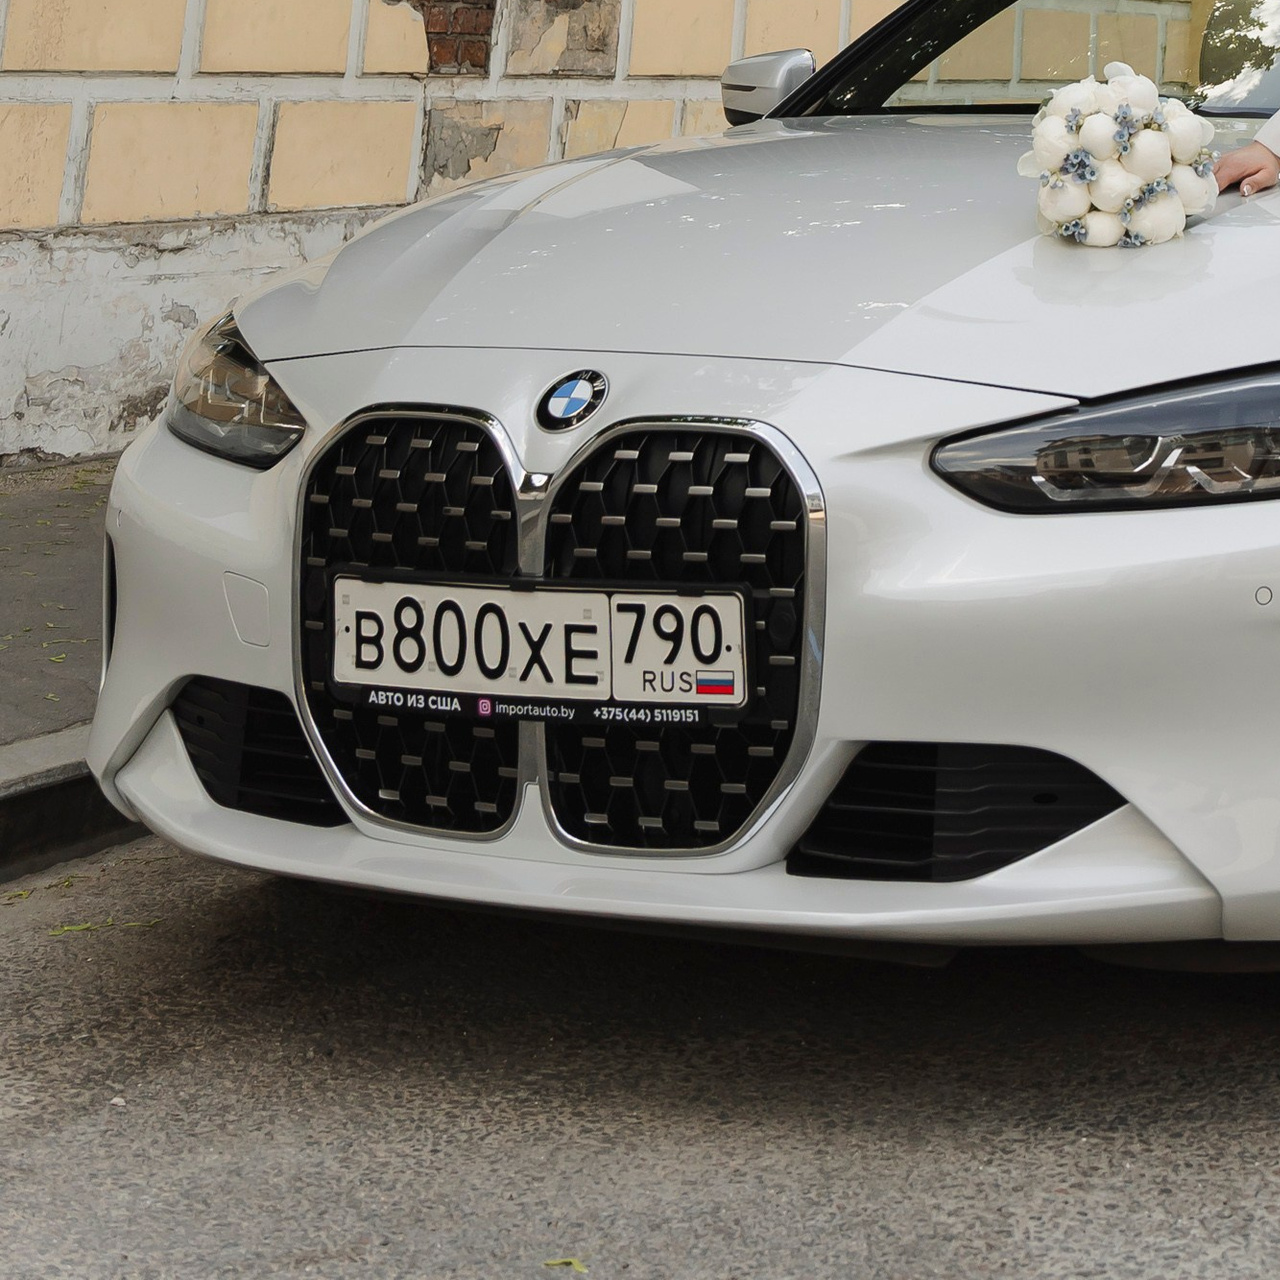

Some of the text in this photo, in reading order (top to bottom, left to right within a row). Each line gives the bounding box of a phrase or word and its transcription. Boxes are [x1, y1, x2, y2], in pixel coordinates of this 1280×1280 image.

[354, 595, 723, 685] В800ХЕ 790
[642, 670, 693, 693] RUS
[368, 690, 462, 711] АВТО ИЗ США
[495, 701, 575, 720] importauto.by
[593, 707, 700, 722] +375(44) 5119151
